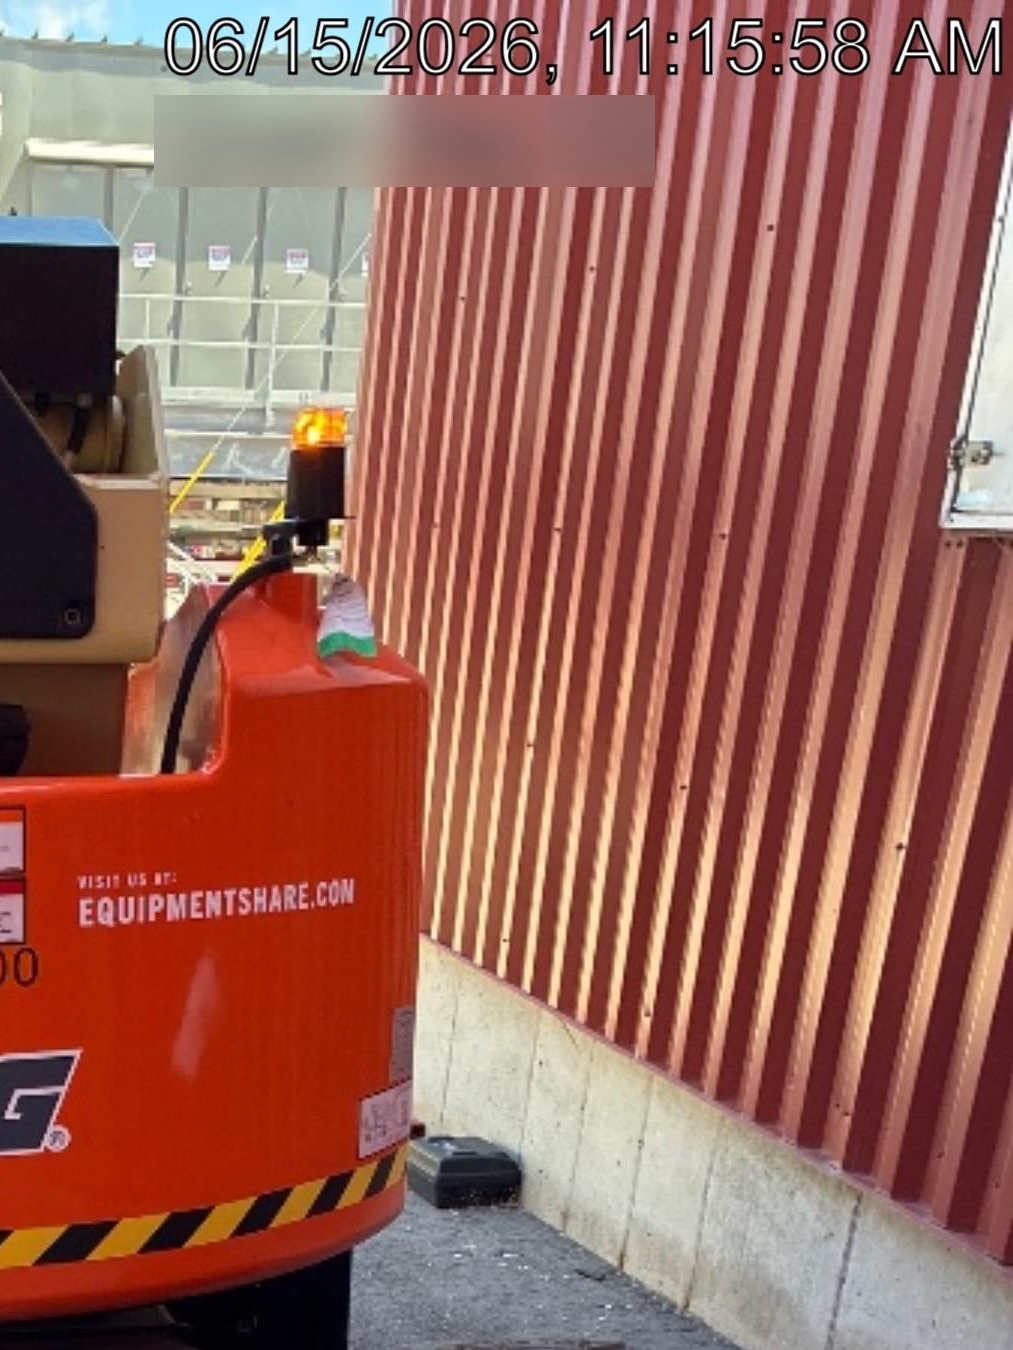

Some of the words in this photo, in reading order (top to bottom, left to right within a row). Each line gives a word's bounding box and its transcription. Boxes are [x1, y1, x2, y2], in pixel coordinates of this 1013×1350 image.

[77, 874, 120, 889] VISIT
[127, 872, 147, 888] US
[79, 878, 355, 927] EQUIPMENTSHARE.COM
